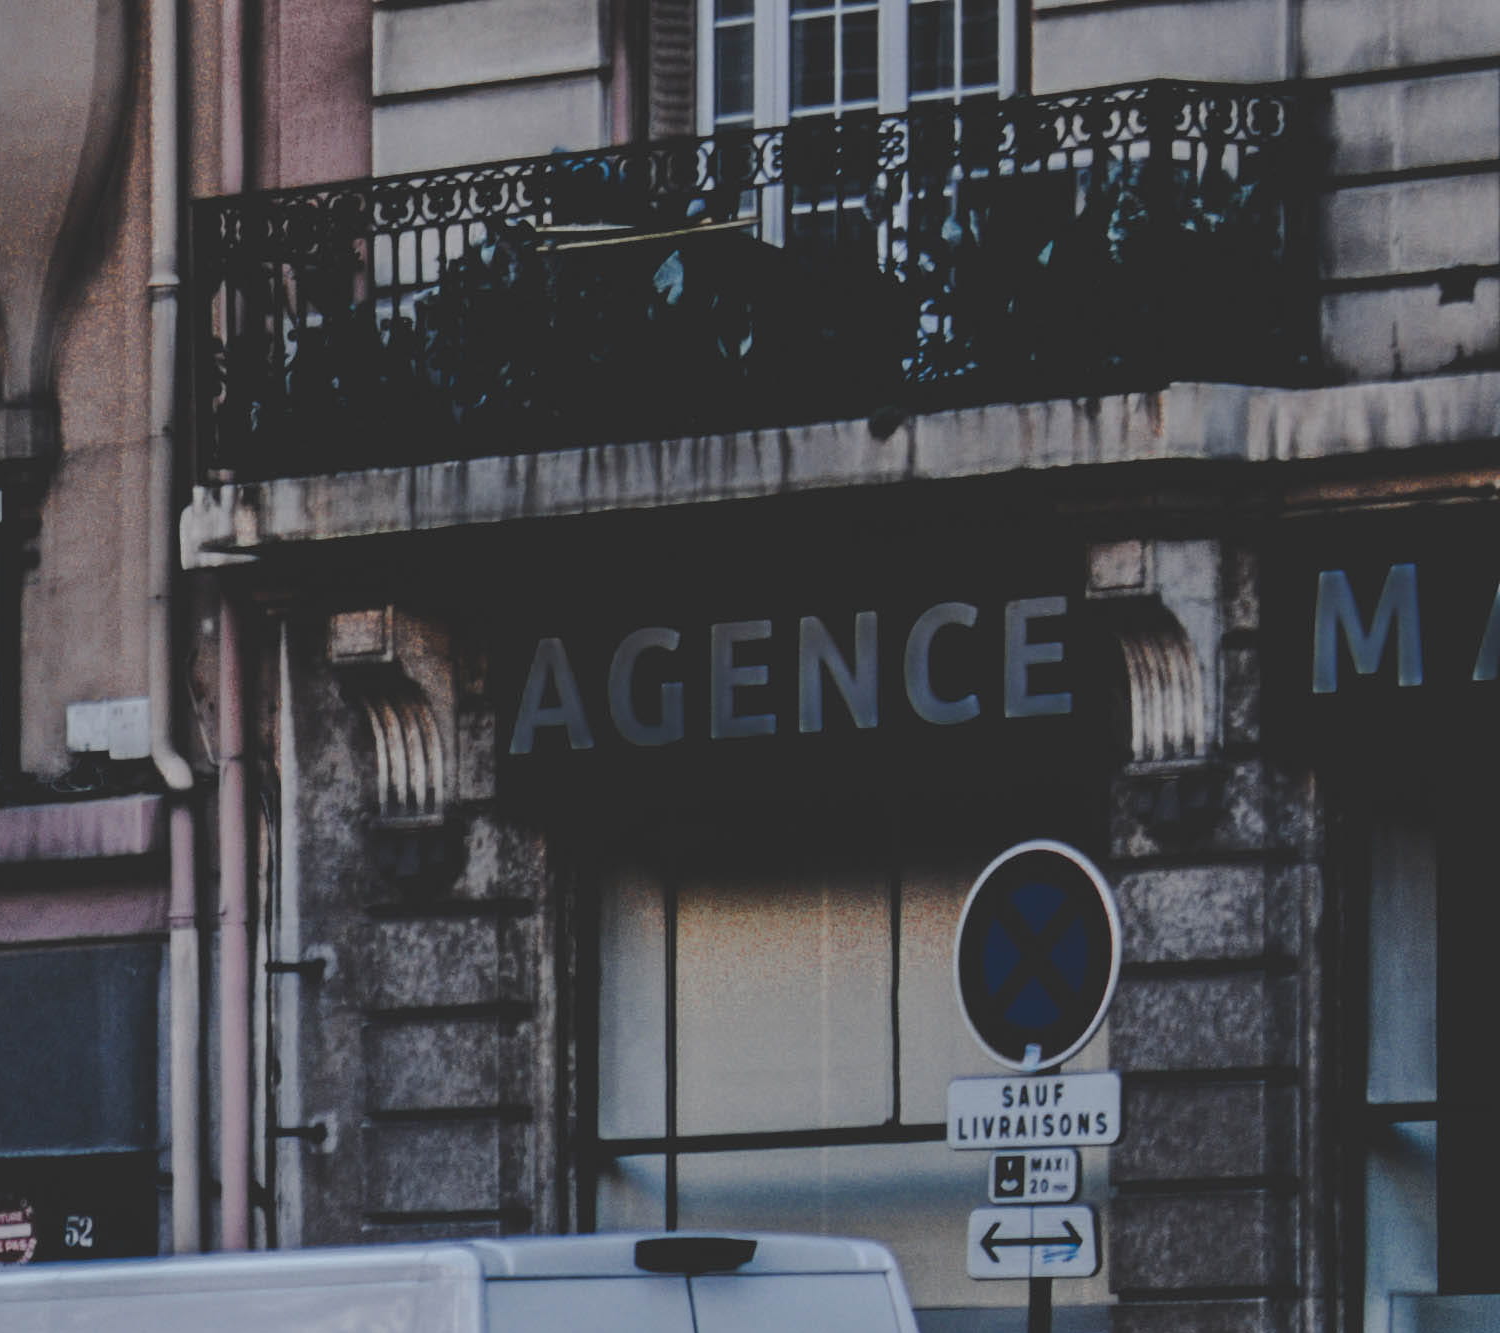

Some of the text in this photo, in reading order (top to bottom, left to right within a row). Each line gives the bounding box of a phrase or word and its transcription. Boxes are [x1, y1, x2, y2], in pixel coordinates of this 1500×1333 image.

[508, 594, 1074, 755] AGENCE
[1002, 1083, 1065, 1108] SAUF
[958, 1112, 1108, 1140] LIVRAISONS
[1030, 1157, 1069, 1173] MAXI
[1029, 1178, 1049, 1195] 20
[64, 1216, 93, 1248] 52
